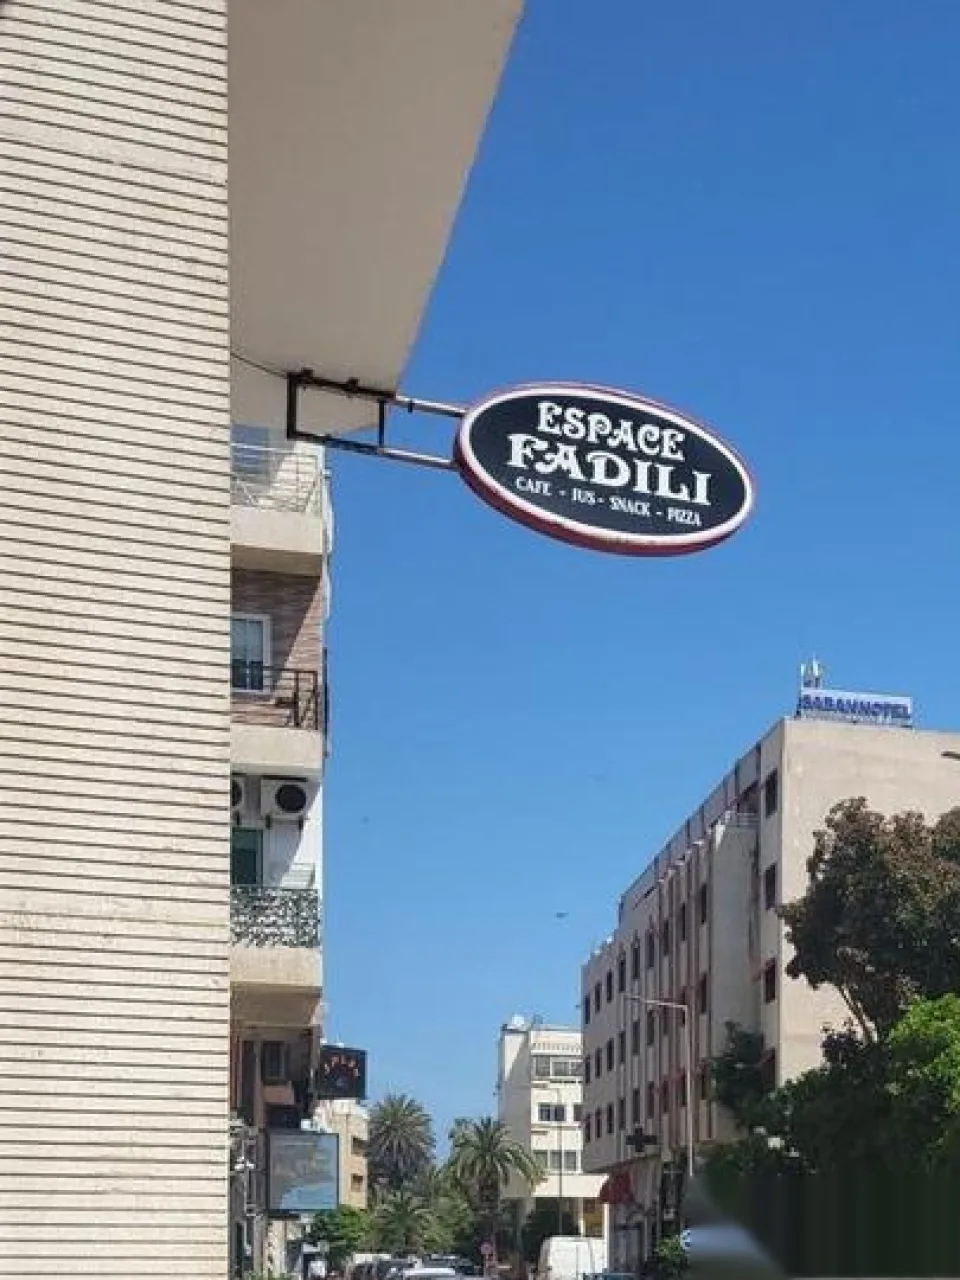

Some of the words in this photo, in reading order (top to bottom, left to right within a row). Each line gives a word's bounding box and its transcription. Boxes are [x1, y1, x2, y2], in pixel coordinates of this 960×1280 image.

[537, 401, 685, 461] ESPACE
[507, 434, 712, 506] FADILI
[609, 495, 650, 517] SNACK
[667, 507, 702, 526] PIZZA
